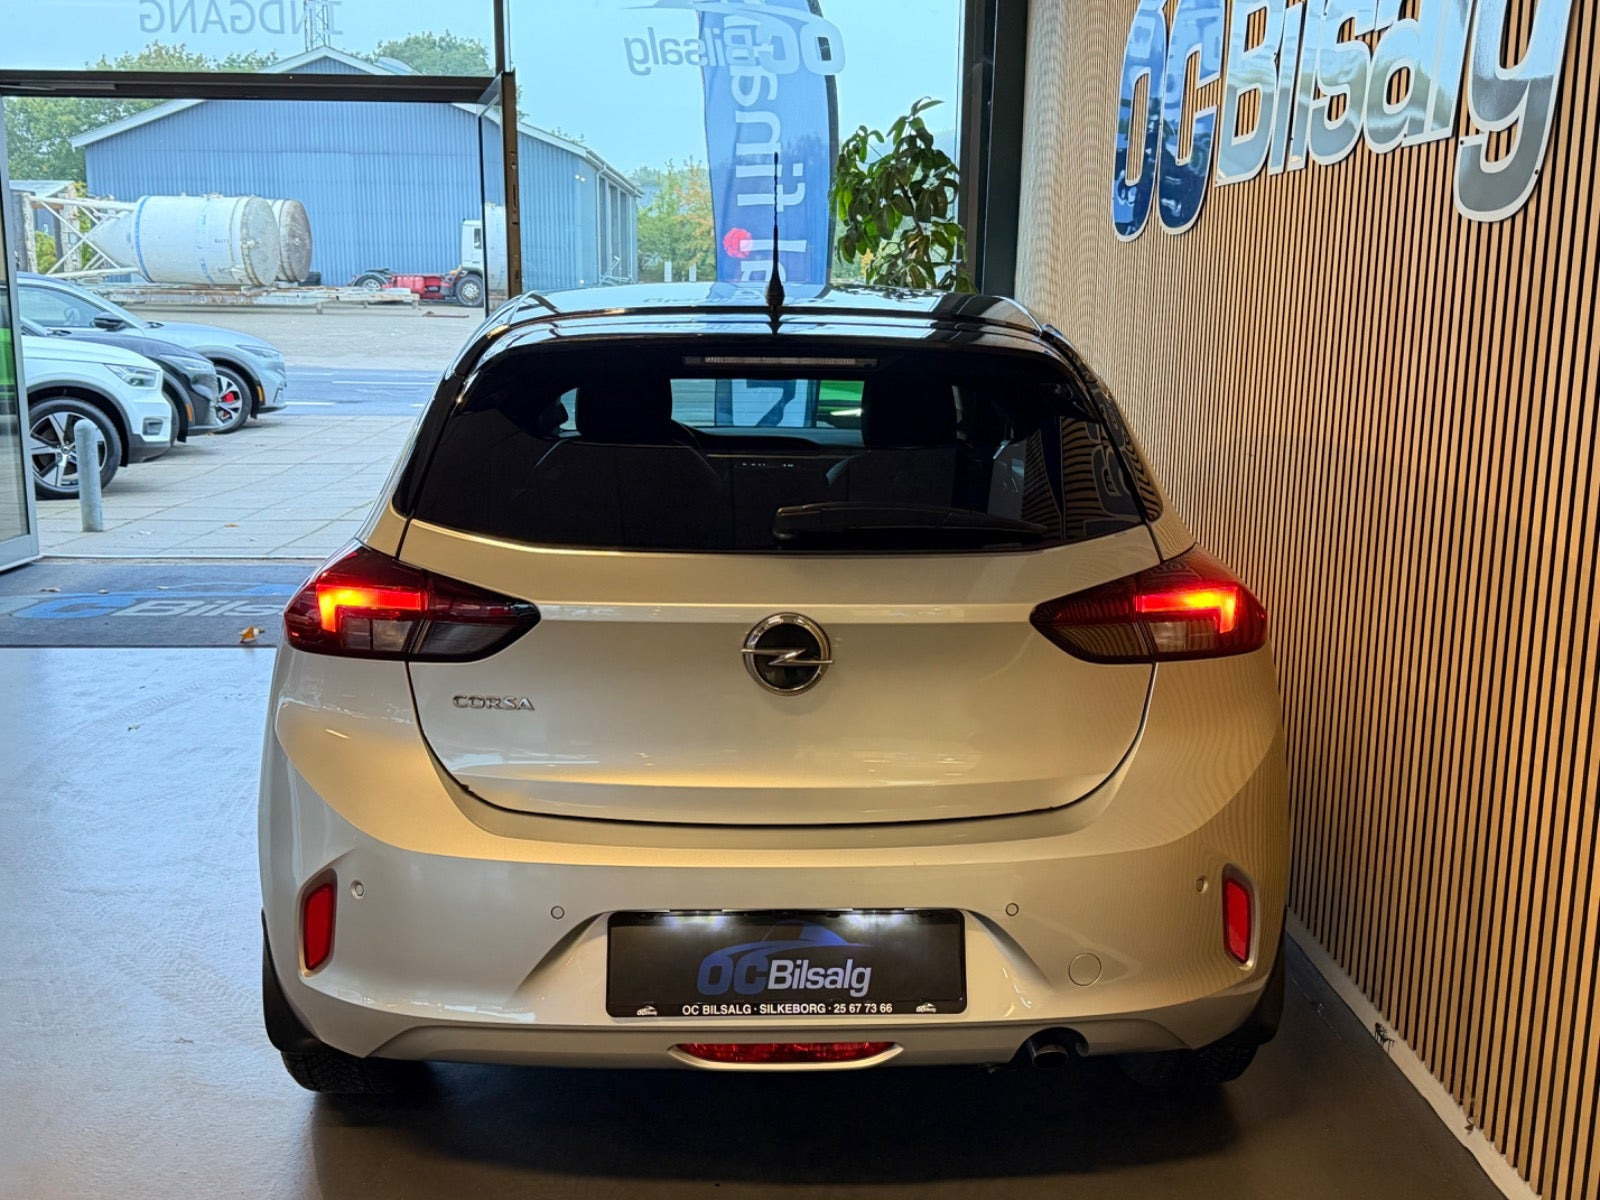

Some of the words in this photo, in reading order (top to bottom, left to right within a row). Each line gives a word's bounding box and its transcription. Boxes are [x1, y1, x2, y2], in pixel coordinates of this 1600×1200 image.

[453, 695, 535, 711] CORSA
[682, 1005, 699, 1015] OC
[702, 1004, 752, 1015] BILSALG
[759, 1003, 826, 1014] SILKEBORG
[834, 1003, 847, 1013] 25
[849, 1003, 861, 1013] 67
[865, 1003, 877, 1013] 73
[879, 1003, 893, 1013] 66
